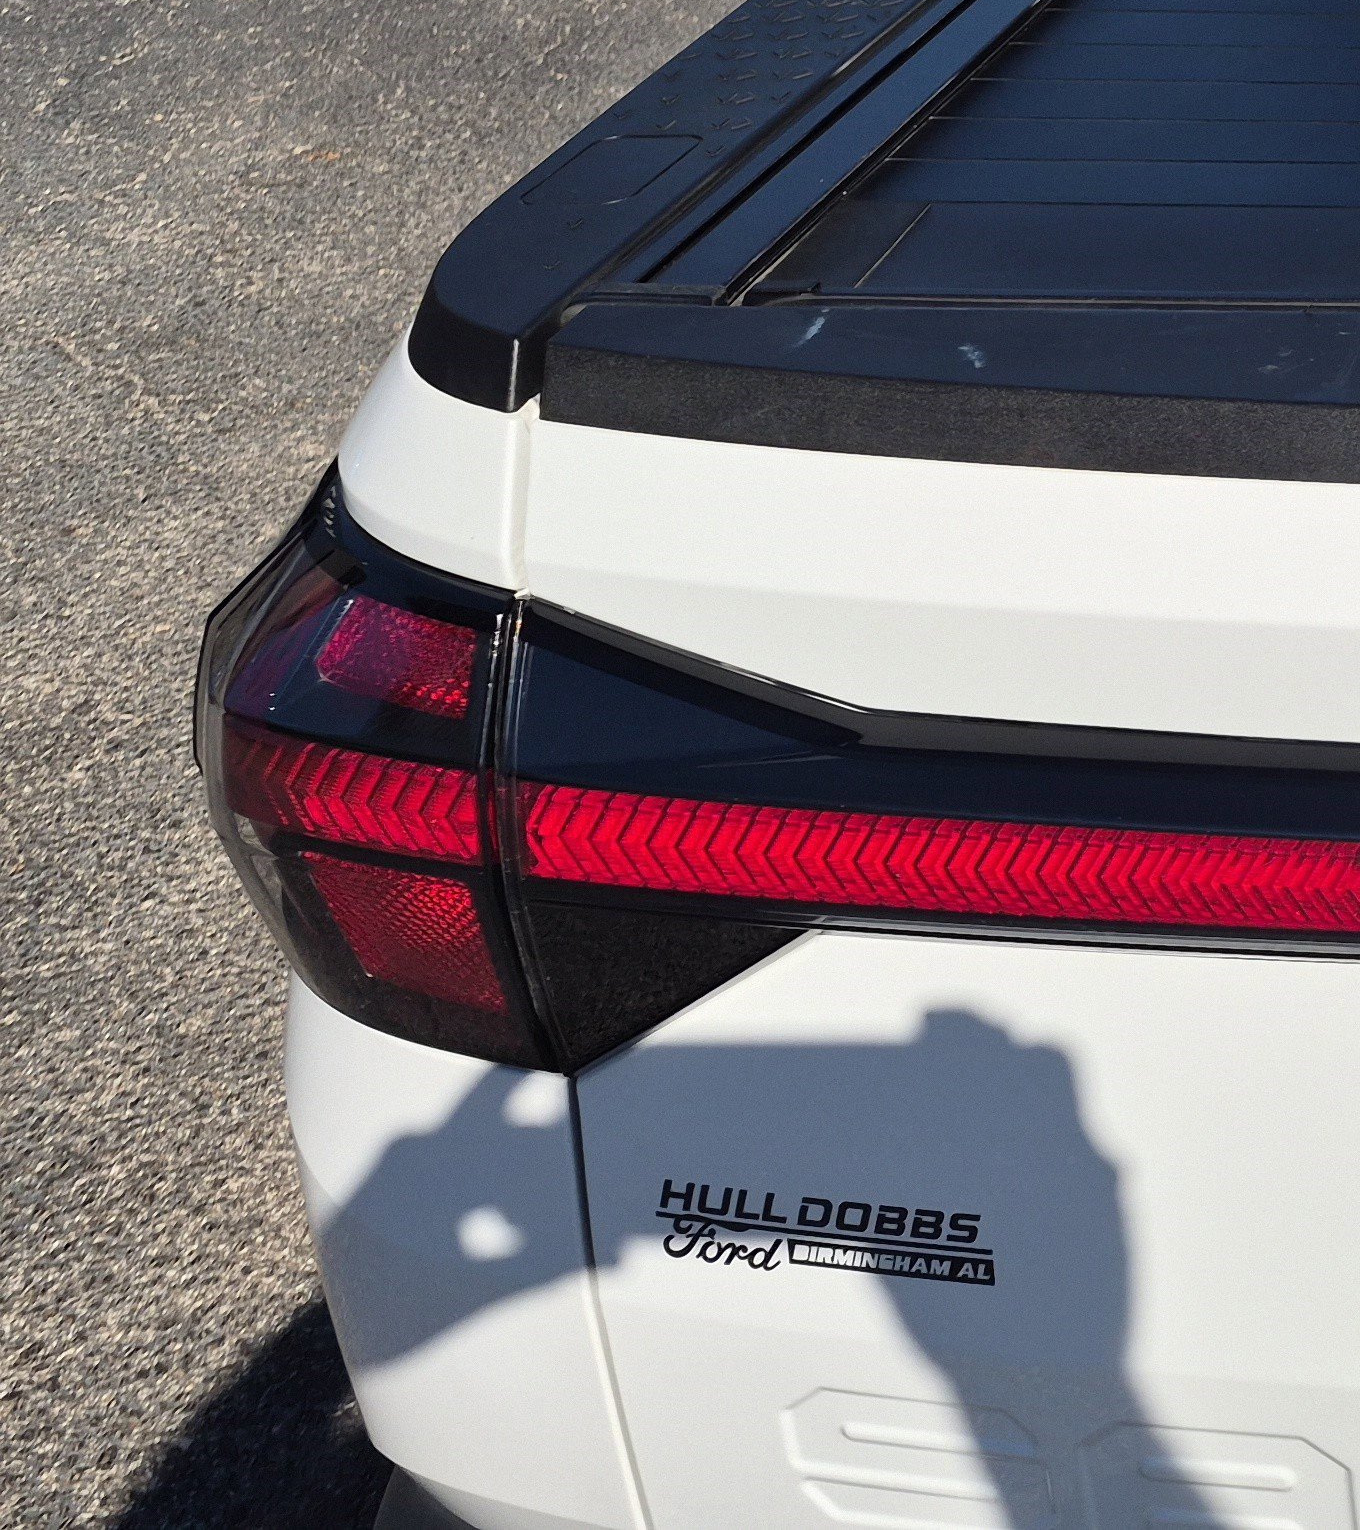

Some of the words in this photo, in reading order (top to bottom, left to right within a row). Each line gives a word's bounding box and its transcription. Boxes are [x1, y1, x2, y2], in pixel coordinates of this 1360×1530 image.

[659, 1178, 788, 1224] HULL
[797, 1196, 982, 1244] DOBBS
[663, 1213, 784, 1271] Ford
[792, 1243, 951, 1277] BIRMINGHAM
[956, 1261, 991, 1281] AL
